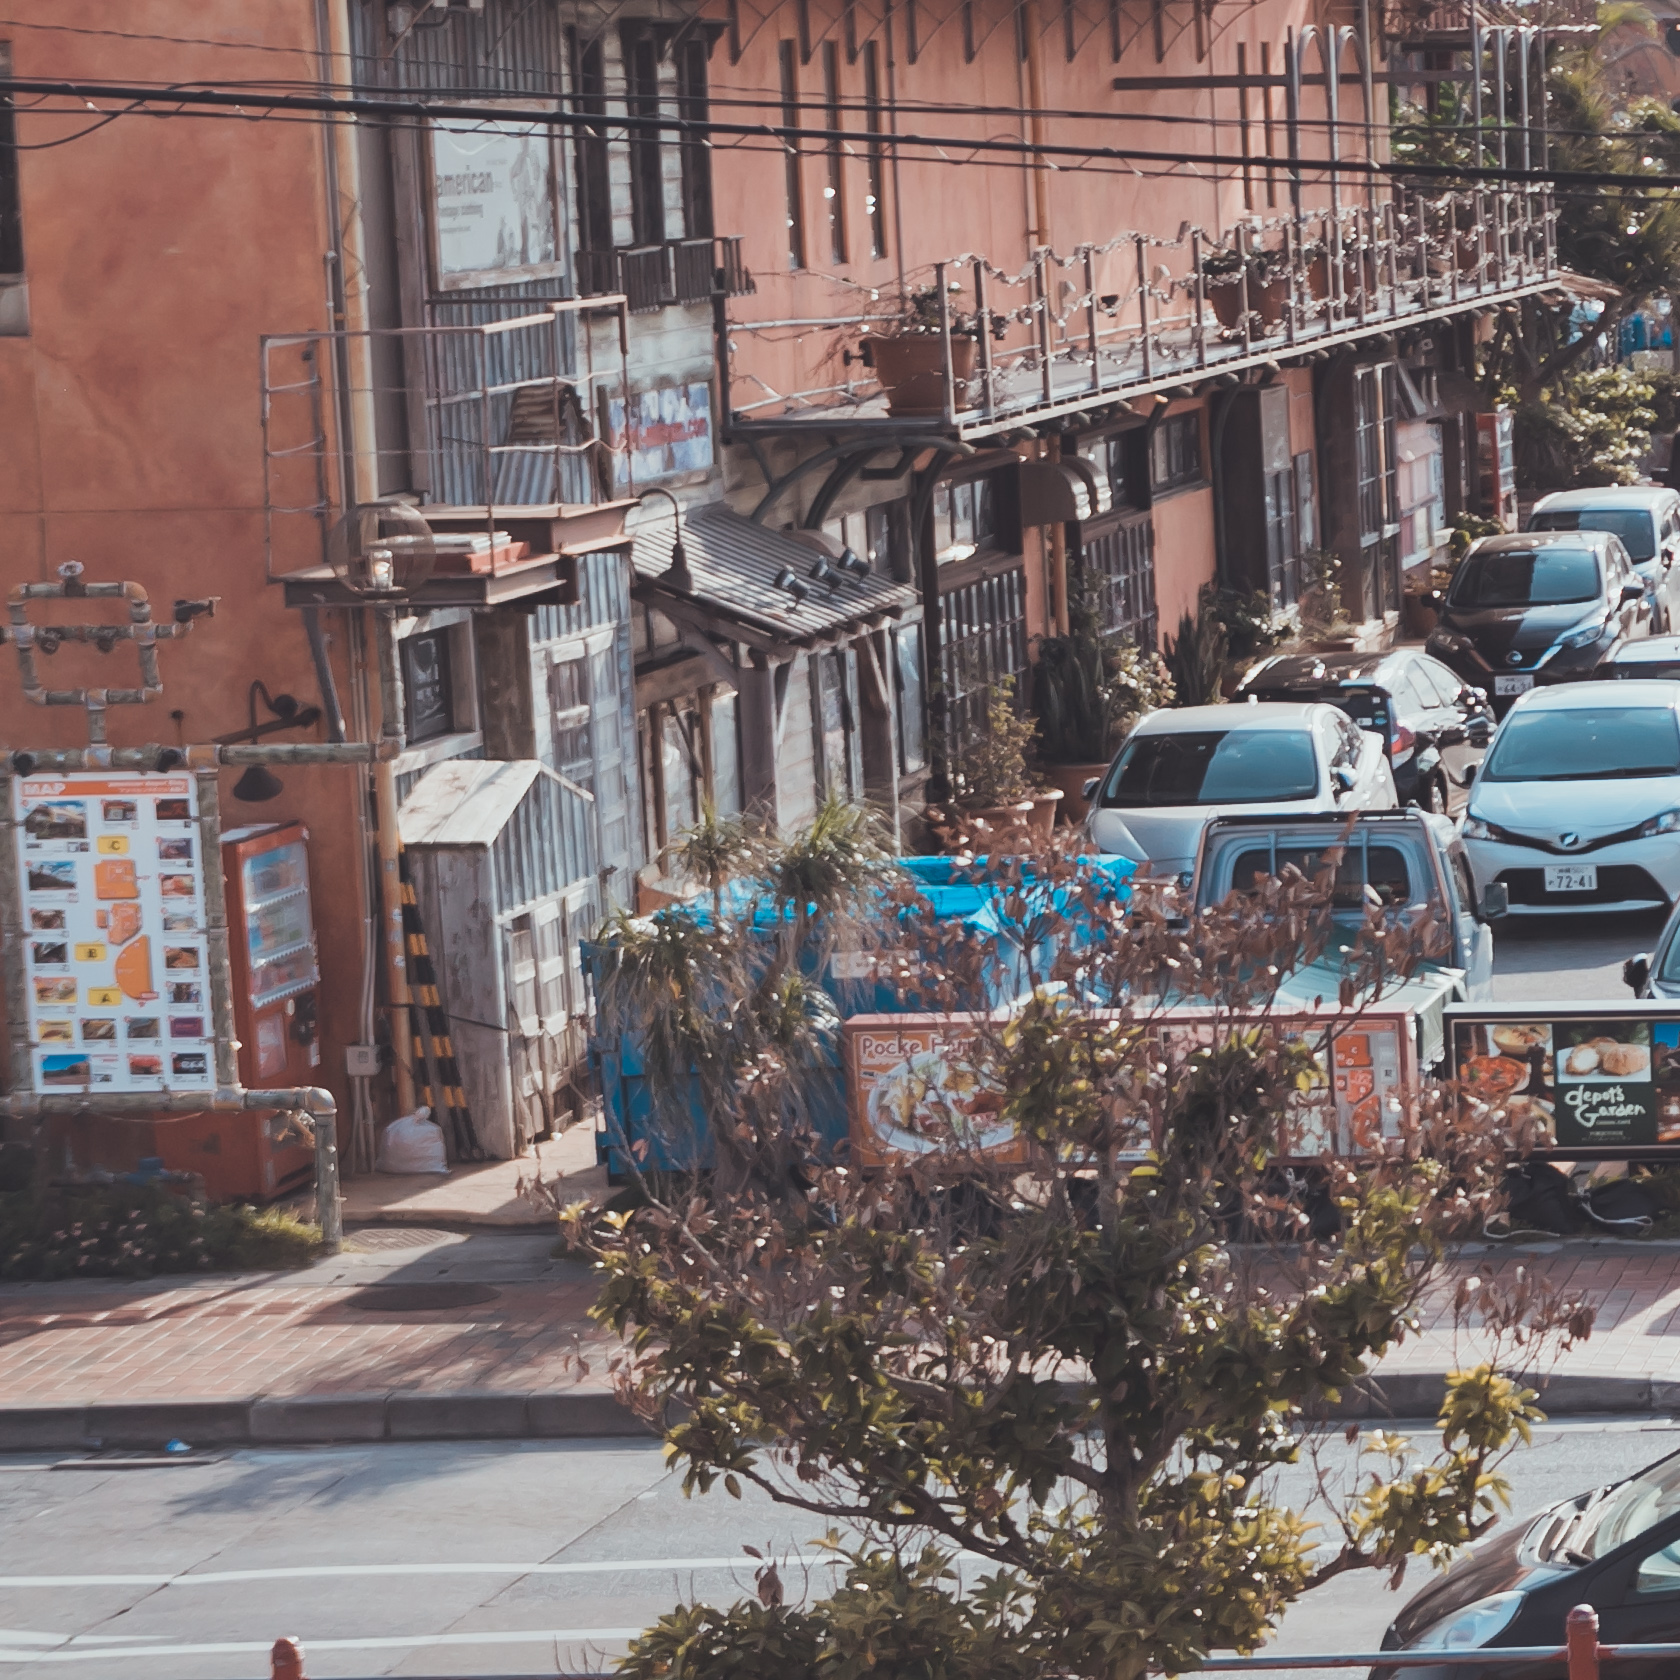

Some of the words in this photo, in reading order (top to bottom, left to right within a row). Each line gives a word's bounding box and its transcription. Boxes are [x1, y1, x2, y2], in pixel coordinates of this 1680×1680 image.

[23, 782, 66, 795] MAP
[862, 1034, 923, 1056] Pocke
[1574, 1103, 1647, 1128] Garden
